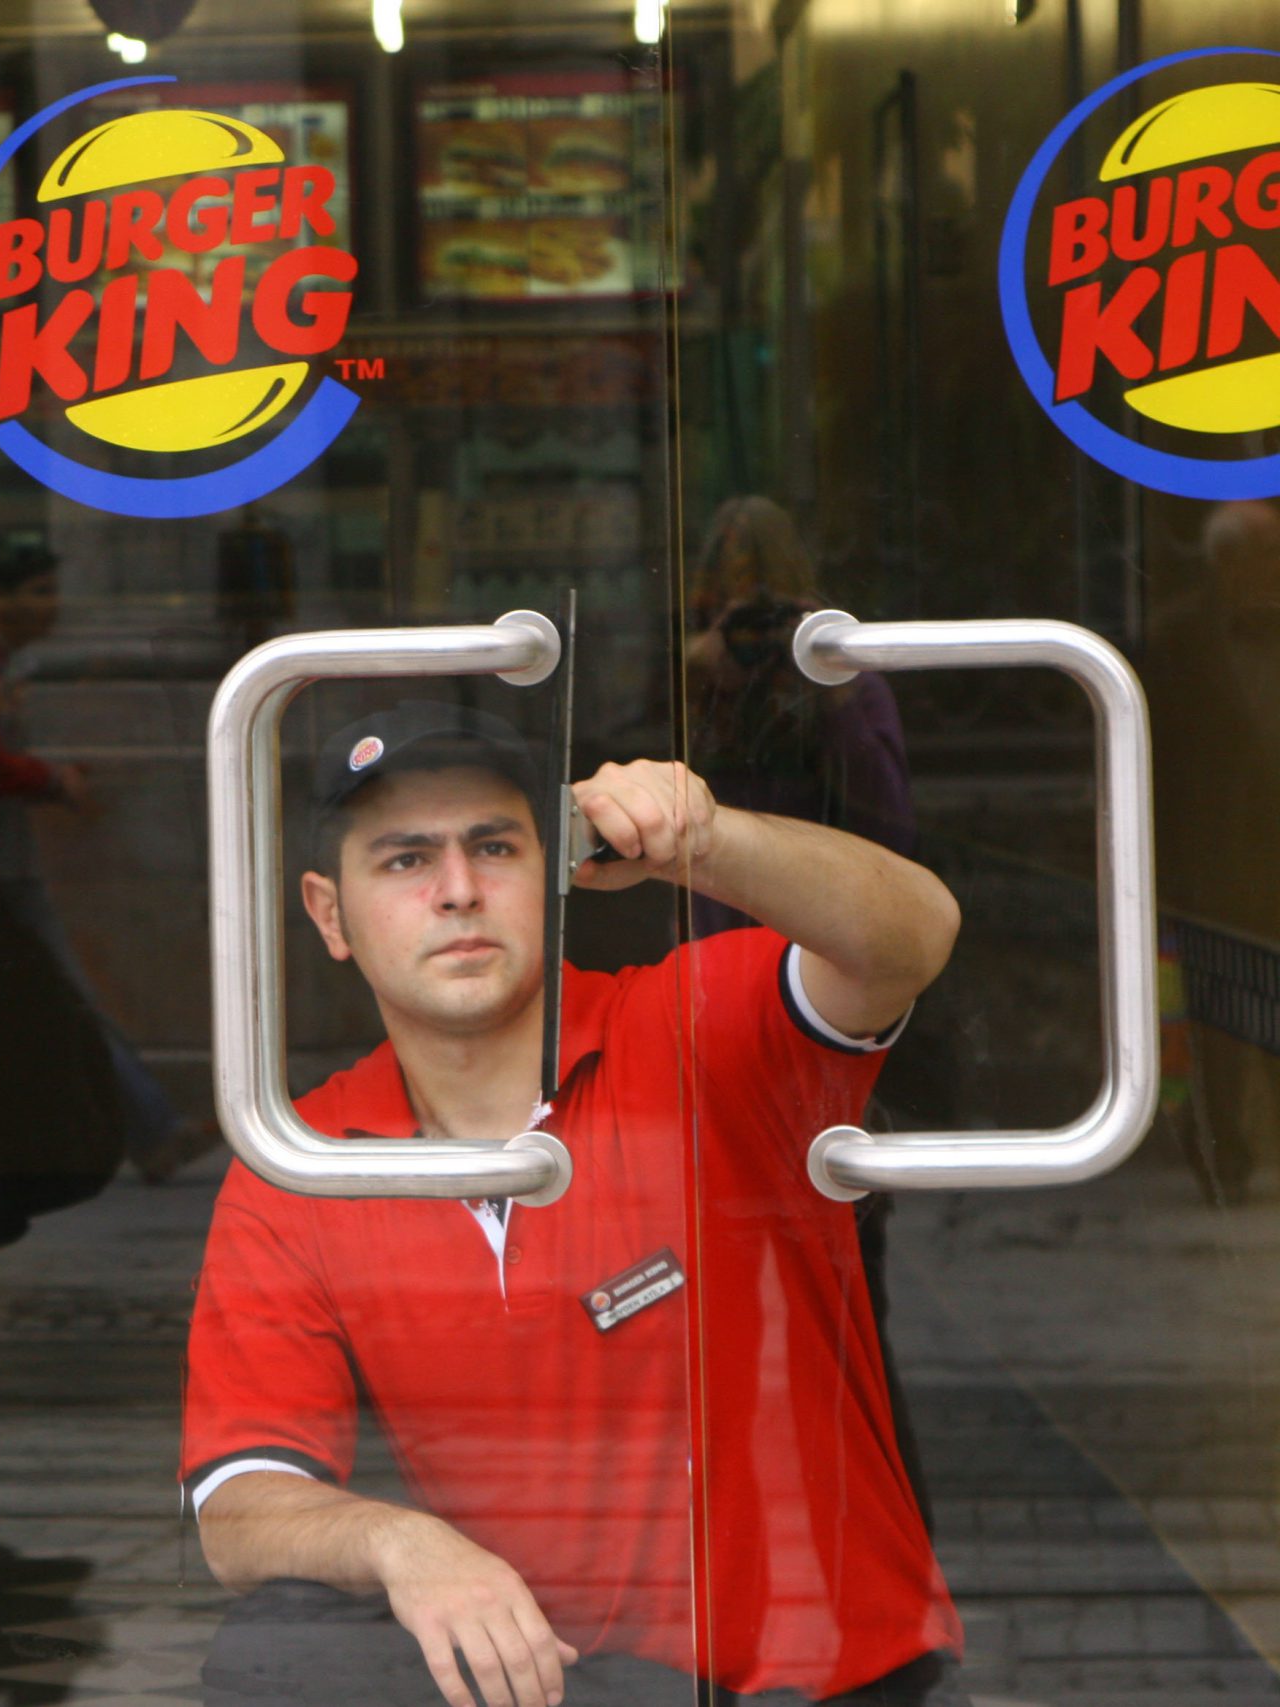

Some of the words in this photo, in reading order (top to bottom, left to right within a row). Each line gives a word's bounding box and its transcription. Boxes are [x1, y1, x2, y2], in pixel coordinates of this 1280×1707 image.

[1048, 151, 1280, 287] BURG
[335, 357, 386, 381] TM
[1056, 243, 1280, 401] KIN
